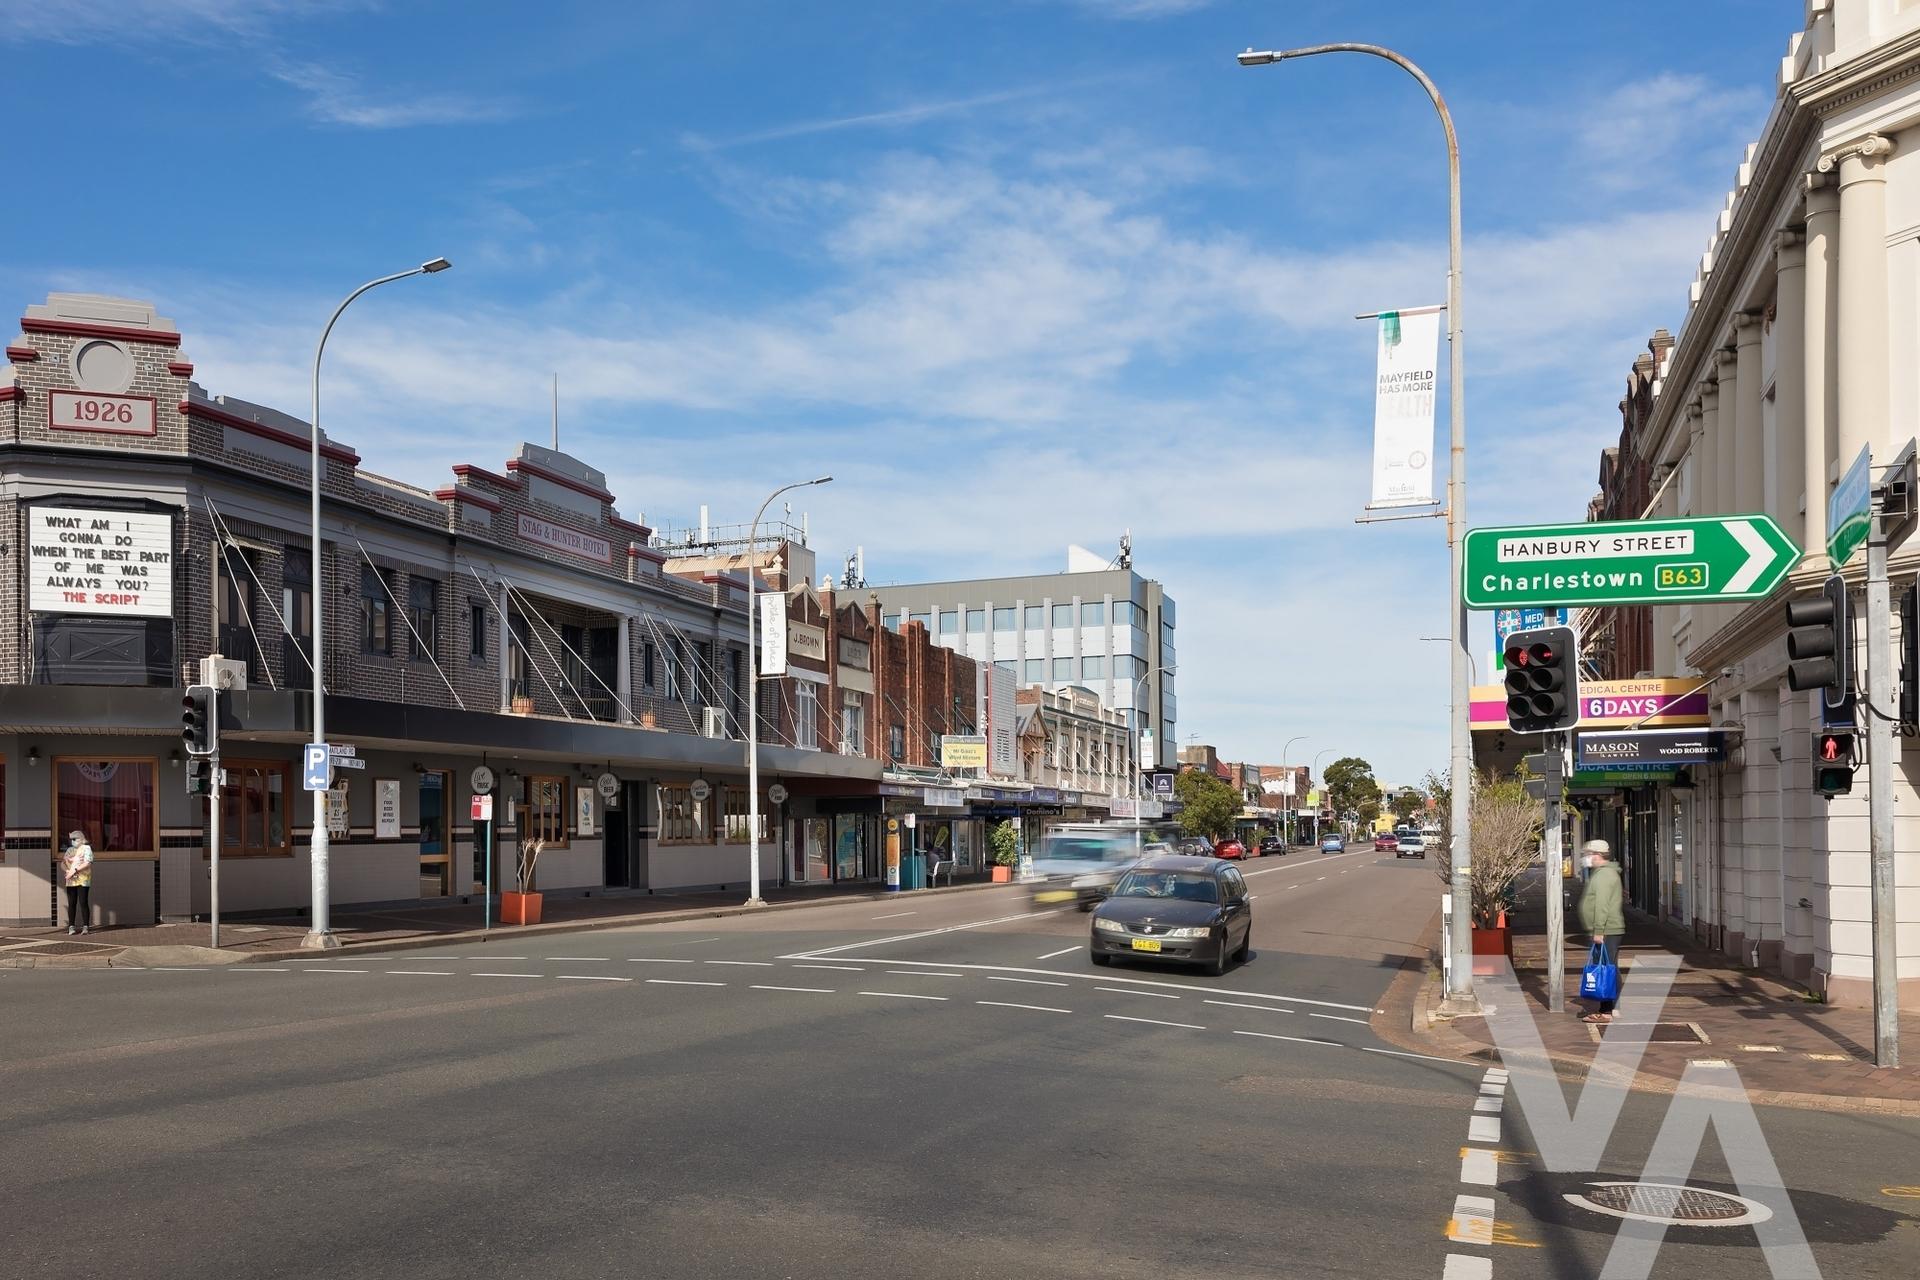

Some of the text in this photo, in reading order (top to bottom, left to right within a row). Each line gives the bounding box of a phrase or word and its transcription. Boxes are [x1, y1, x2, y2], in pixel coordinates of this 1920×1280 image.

[1380, 370, 1433, 384] MAYFIELD
[1380, 381, 1433, 394] HAS MORE
[74, 400, 133, 423] 1926
[1382, 393, 1432, 418] EALTH
[45, 516, 130, 531] WHAT AM I
[59, 532, 133, 546] GONNA DO
[522, 518, 607, 556] STAG & HUNTER HOTEL
[1503, 536, 1687, 556] HANBURY STREET
[31, 545, 170, 563] WHEN THE BEST PART
[54, 562, 148, 576] OF ME WAS
[46, 576, 149, 591] ALWAYS YOU?
[1482, 568, 1702, 591] Charlestown B63
[62, 591, 140, 605] THE SCRIPT
[1579, 683, 1662, 695] EDICAL CENTRE
[1586, 742, 1639, 752] MASON
[1684, 746, 1718, 754] ROBERTS
[309, 748, 326, 771] P
[1622, 772, 1644, 780] OPEN
[1026, 807, 1060, 815] Domino's
